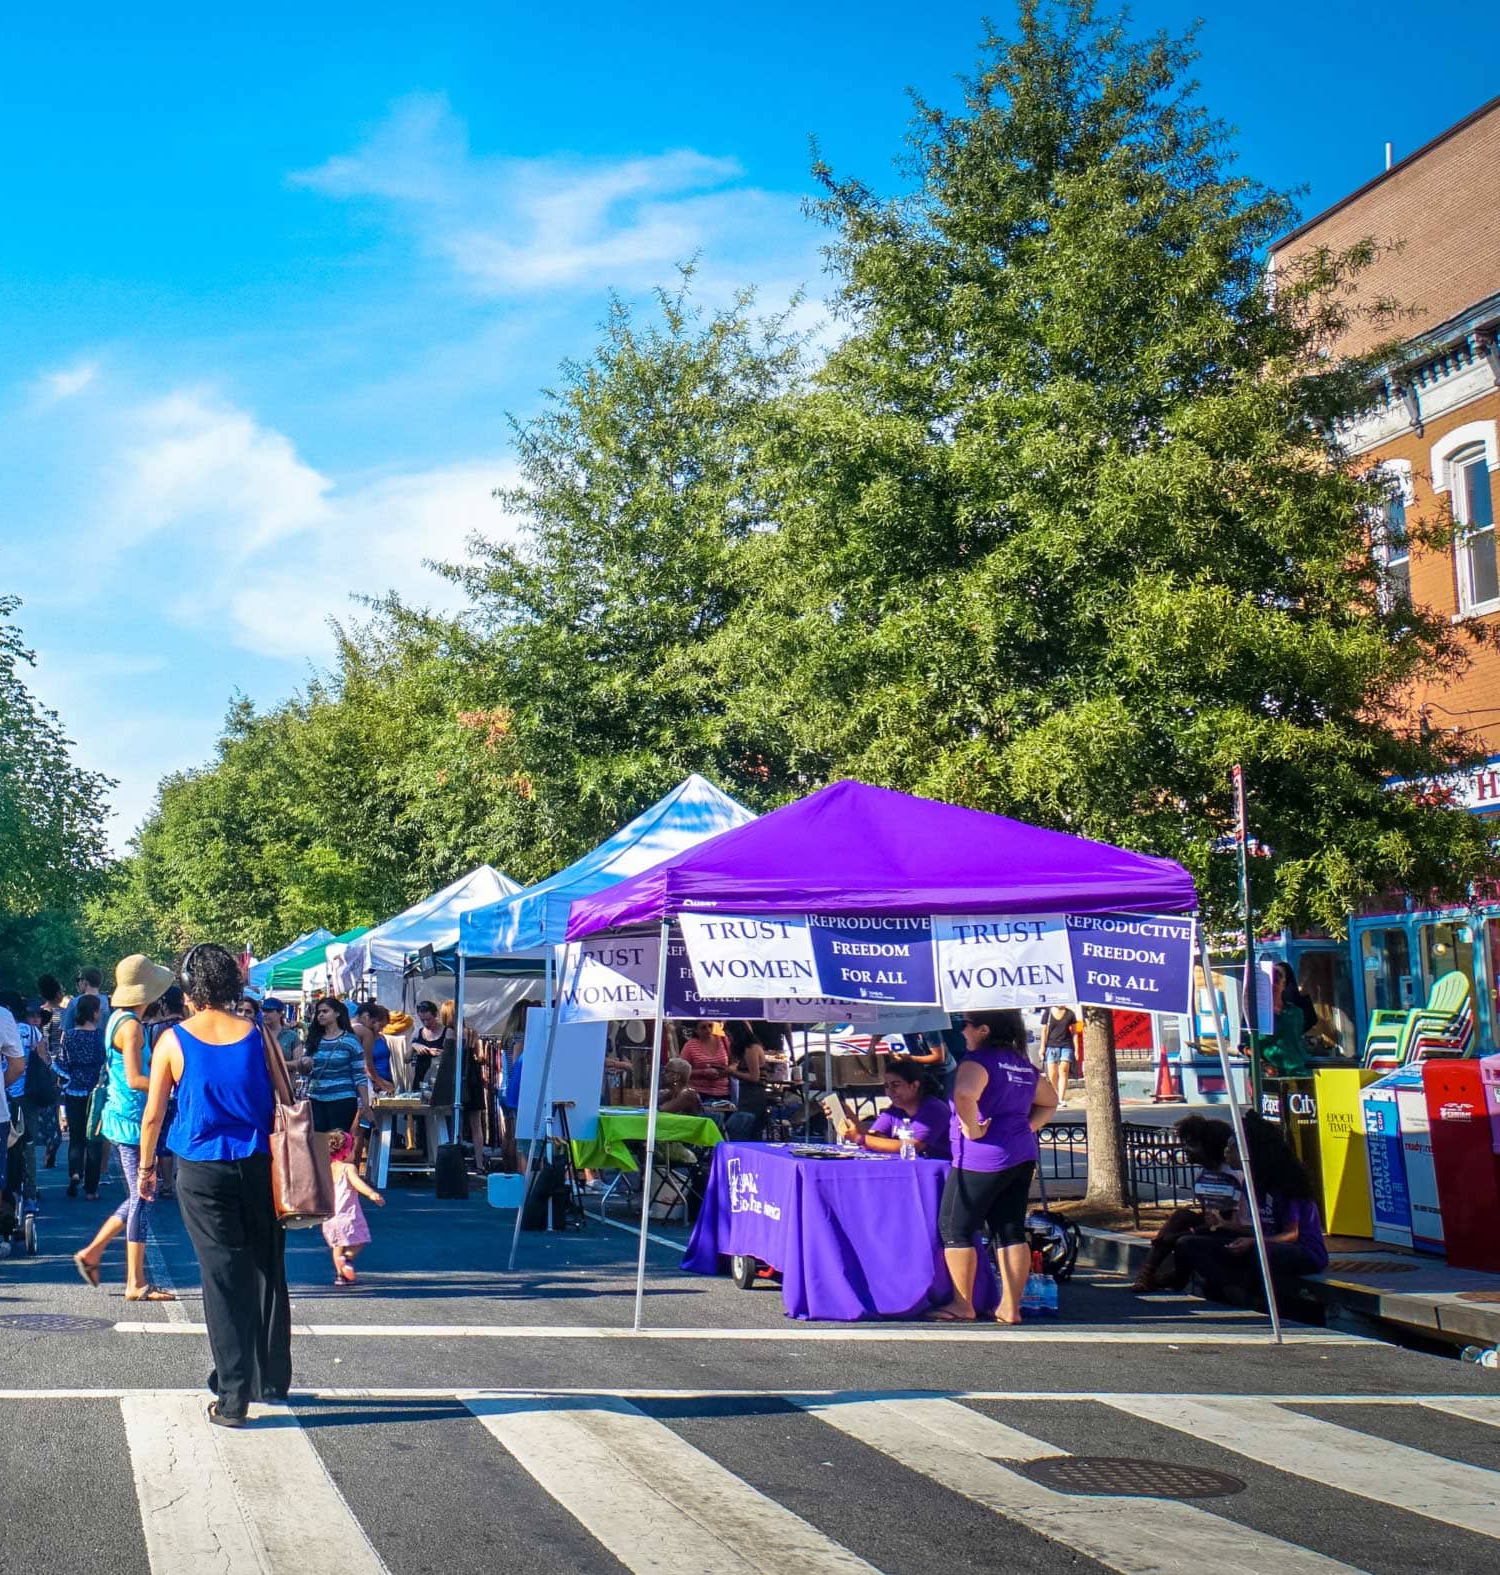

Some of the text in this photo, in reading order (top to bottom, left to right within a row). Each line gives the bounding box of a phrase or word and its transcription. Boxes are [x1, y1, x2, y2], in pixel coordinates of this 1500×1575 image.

[700, 920, 792, 940] TRUST
[809, 913, 931, 930] REPRODUCTIVE
[1065, 913, 1190, 940] REPRODUCTIVE
[952, 920, 1047, 946] TRUST
[568, 947, 645, 970] TRUST
[831, 940, 911, 957] FREEDOM
[1082, 942, 1166, 965] FREEDOM
[700, 959, 814, 978] WOMEN
[840, 967, 908, 985] FOR ALL
[947, 963, 1066, 990] WOMEN
[1086, 970, 1159, 992] FOR ALL
[563, 983, 657, 1006] WOMEN
[1326, 1112, 1354, 1123] EPOCH
[1328, 1122, 1353, 1133] TIMES
[1366, 1108, 1388, 1213] APARTMENT
[1380, 1133, 1395, 1214] SHOWCASE
